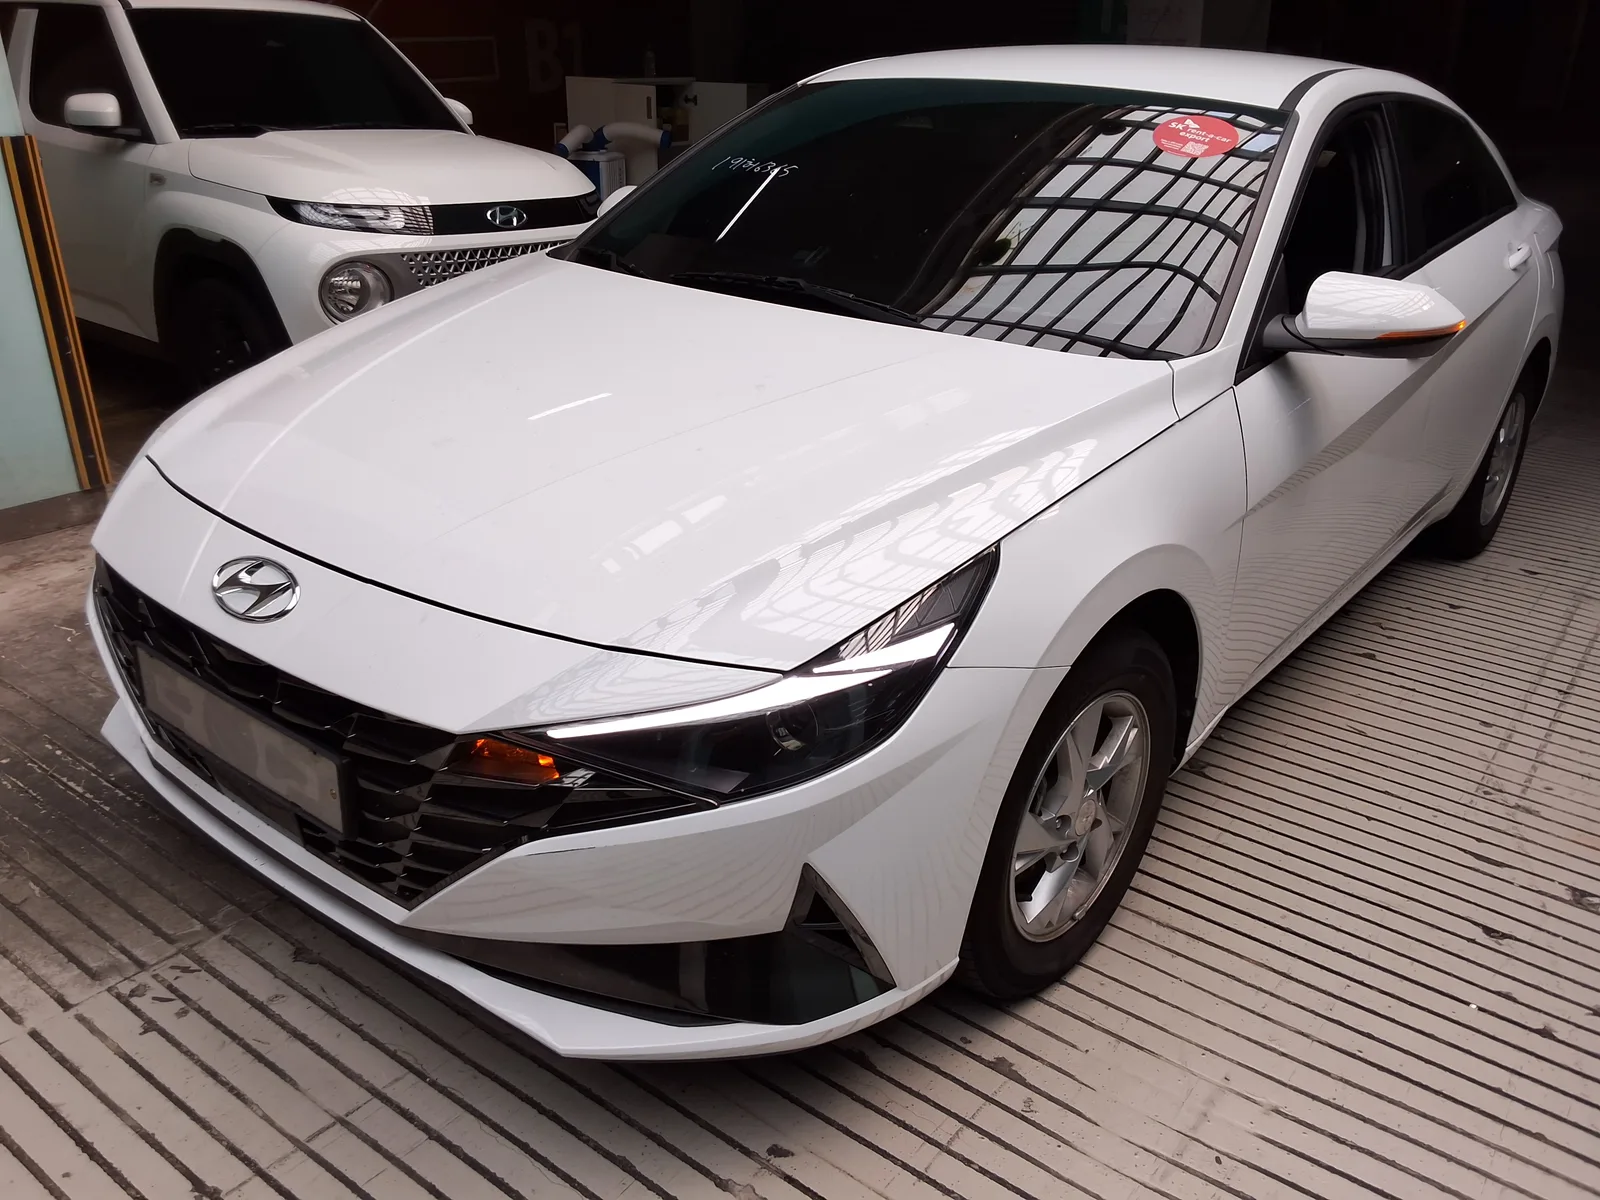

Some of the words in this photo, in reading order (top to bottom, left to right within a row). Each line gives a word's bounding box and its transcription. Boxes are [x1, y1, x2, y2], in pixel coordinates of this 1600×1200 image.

[523, 16, 583, 93] B1
[1168, 121, 1187, 131] SK
[1187, 128, 1232, 143] rent-a-car
[1179, 131, 1210, 143] export
